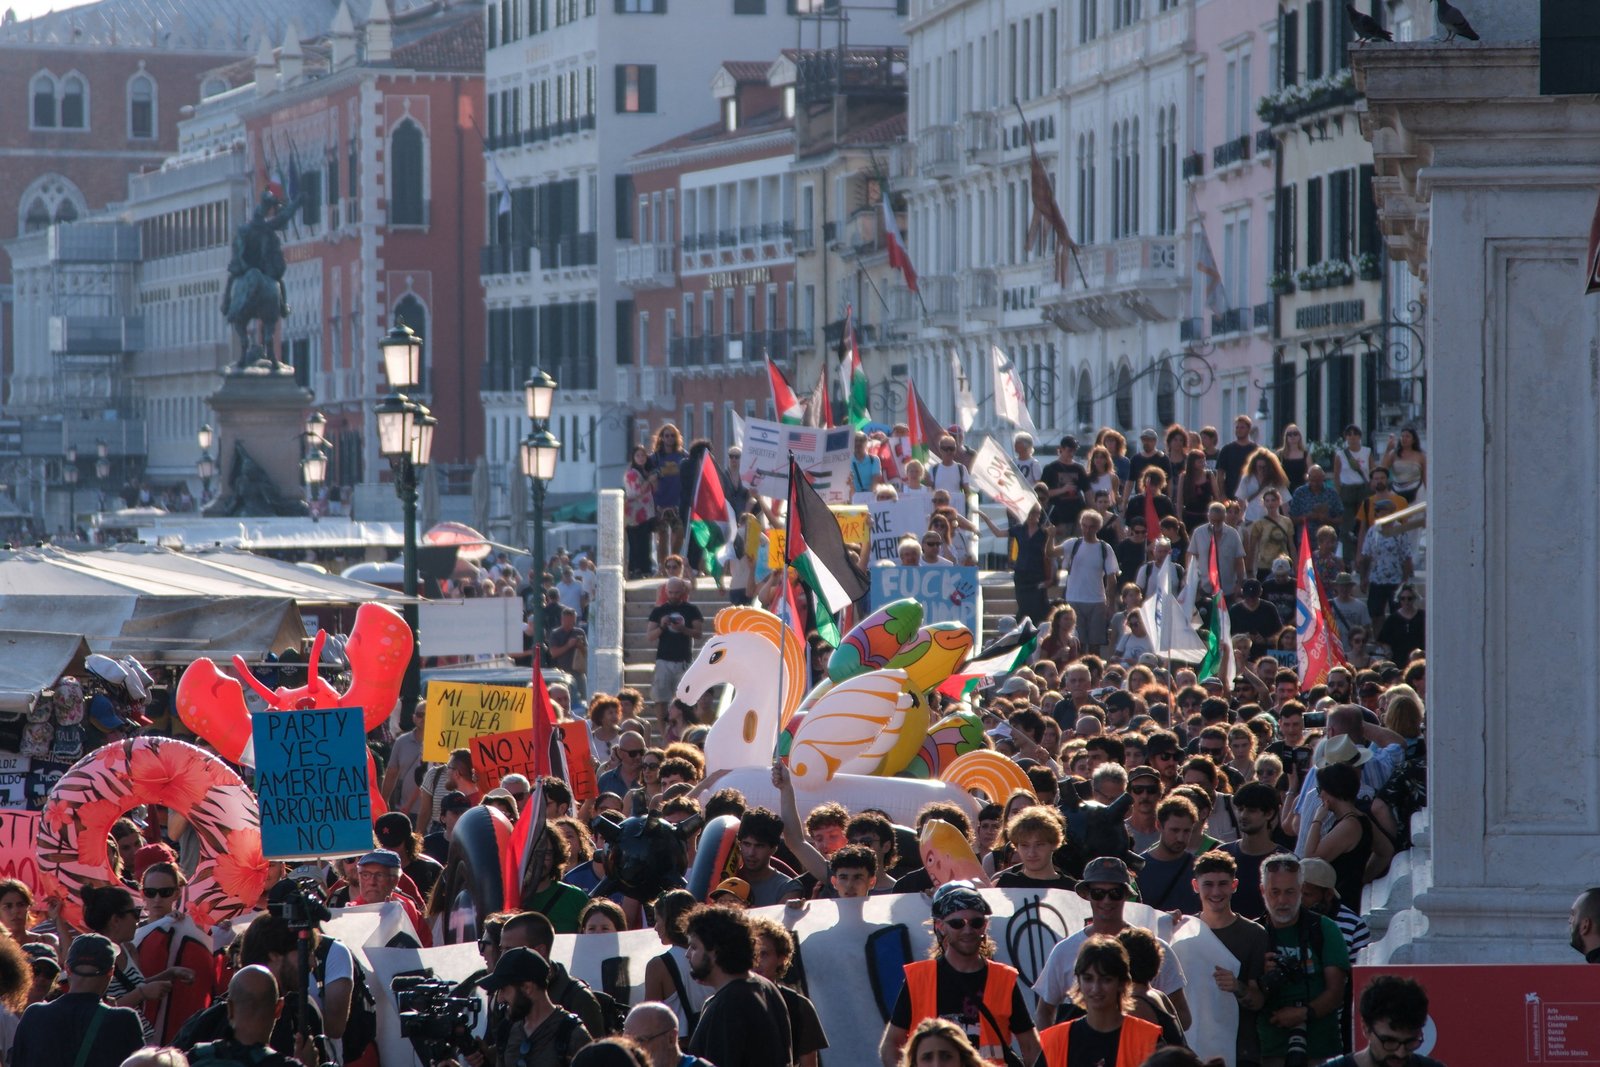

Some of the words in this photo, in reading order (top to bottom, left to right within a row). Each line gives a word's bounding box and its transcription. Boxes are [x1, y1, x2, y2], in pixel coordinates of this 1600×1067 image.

[882, 568, 961, 600] FUCK
[438, 688, 463, 708] MI
[479, 690, 527, 714] VORIA
[268, 711, 348, 740] PARTY
[451, 710, 501, 731] VEDER
[280, 739, 331, 767] YES
[438, 730, 461, 749] STI
[478, 738, 514, 766] NO
[258, 766, 368, 797] AMERICAN
[260, 793, 370, 825] ARROGANCE
[297, 823, 335, 850] NO
